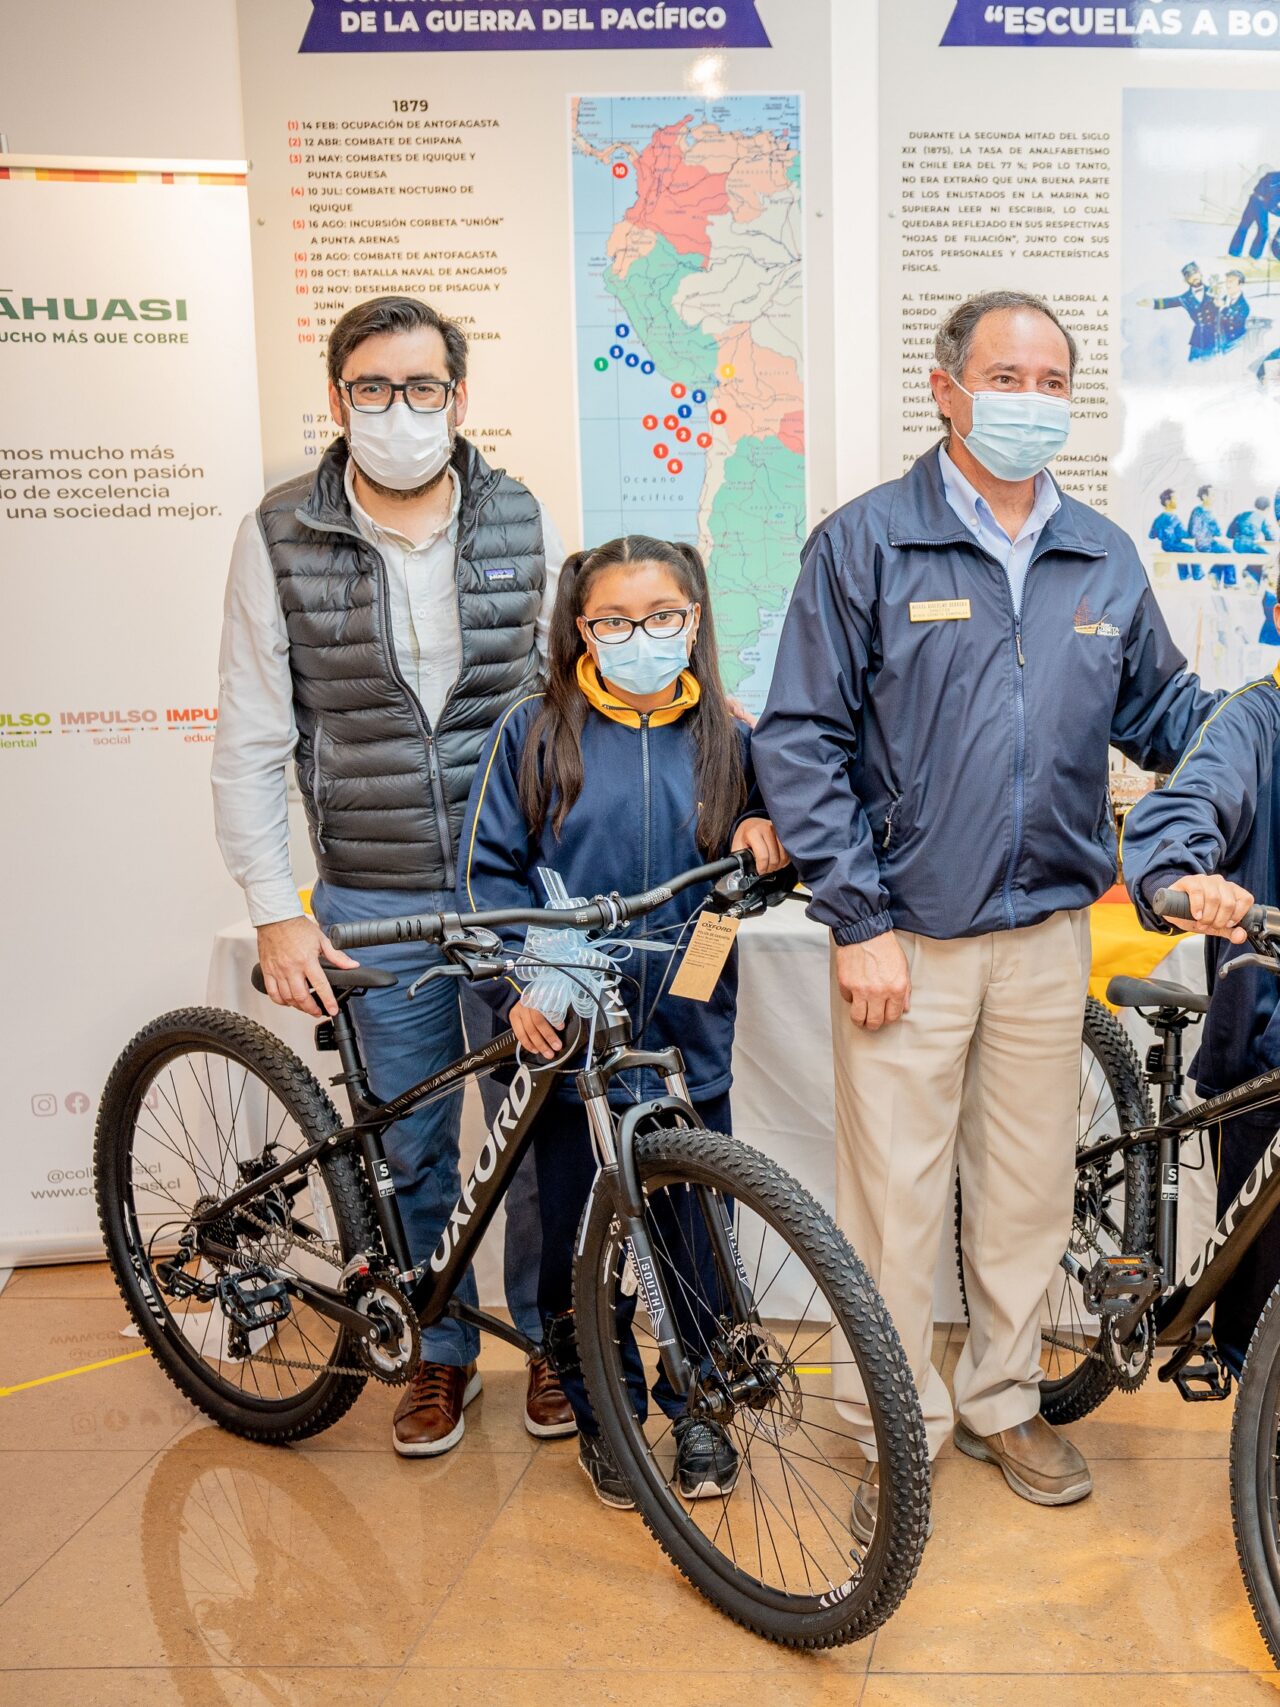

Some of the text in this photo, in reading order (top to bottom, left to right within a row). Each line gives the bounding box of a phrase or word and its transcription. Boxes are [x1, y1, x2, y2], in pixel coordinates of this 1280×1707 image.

[340, 2, 728, 34] DE LA GUERRA DEL PACÍFICO
[984, 6, 1182, 36] “ESCUELAS
[1190, 9, 1219, 38] A
[392, 99, 428, 112] 1879
[287, 120, 298, 131] (1)
[315, 121, 338, 129] FEB:
[341, 120, 403, 129] OCUPACIÓN
[406, 120, 420, 128] DE
[423, 119, 499, 128] ANTOFAGASTA
[958, 131, 970, 139] LA
[1024, 131, 1055, 140] MITAD
[1059, 132, 1077, 140] DEL
[1081, 132, 1110, 140] SIGLO
[923, 146, 953, 154] (1875),
[1009, 146, 1022, 154] DE
[1028, 147, 1110, 155] ANALFABETISMO
[288, 153, 302, 164] (3)
[305, 154, 314, 163] 21
[318, 154, 342, 162] MAY:
[345, 154, 402, 162] COMBATES
[405, 153, 419, 161] DE
[422, 152, 466, 162] IQUIQUE
[345, 170, 387, 178] GRUESA
[290, 185, 473, 196] (4) 10 JUL: COMBATE NOCTURNO DE
[921, 190, 939, 198] LOS
[1012, 191, 1025, 199] EN
[1031, 191, 1043, 199] LA
[1095, 191, 1109, 199] NO
[309, 203, 352, 213] IQUIQUE
[901, 205, 950, 213] SUPIERAN
[1008, 205, 1055, 213] ESCRIBIR,
[1063, 205, 1076, 214] LO
[292, 219, 305, 229] (5)
[321, 220, 346, 228] AGO:
[349, 219, 406, 227] INCURSIÓN
[409, 218, 457, 227] CORBETA
[901, 219, 1109, 228] QUEDABA REFLEJADO EN SUS RESPECTIVAS
[358, 235, 400, 243] ARENAS
[944, 234, 957, 242] DE
[1063, 235, 1084, 243] CON
[1090, 235, 1109, 243] SUS
[293, 251, 497, 262] (6) 28 AGO: COMBATE DE ANTOFAGASTA
[294, 268, 307, 278] (7)
[310, 269, 323, 277] 08
[326, 268, 349, 277] OCT:
[352, 268, 398, 276] BATALLA
[438, 267, 452, 276] DE
[901, 264, 940, 272] FÍSICAS.
[295, 285, 309, 294] (8)
[311, 285, 324, 294] 02
[354, 284, 426, 292] DESEMBARCO
[428, 284, 442, 292] DE
[445, 283, 490, 292] PISAGUA
[52, 330, 88, 344] MÁS
[94, 332, 128, 344] QUE
[133, 332, 190, 344] COBRE
[50, 446, 124, 460] mucho
[130, 444, 175, 460] más
[88, 467, 128, 480] con
[134, 464, 204, 482] pasión
[23, 484, 170, 499] de excelencia
[6, 503, 222, 520] una sociedad mejor.
[60, 710, 158, 725] IMPULSO
[166, 708, 218, 722] IMPU
[92, 734, 132, 746] social
[702, 922, 732, 933] OXFORD
[379, 1163, 389, 1177] S
[430, 1064, 533, 1273] OXFORD
[1167, 1168, 1178, 1182] S
[641, 1262, 662, 1307] SOUTH
